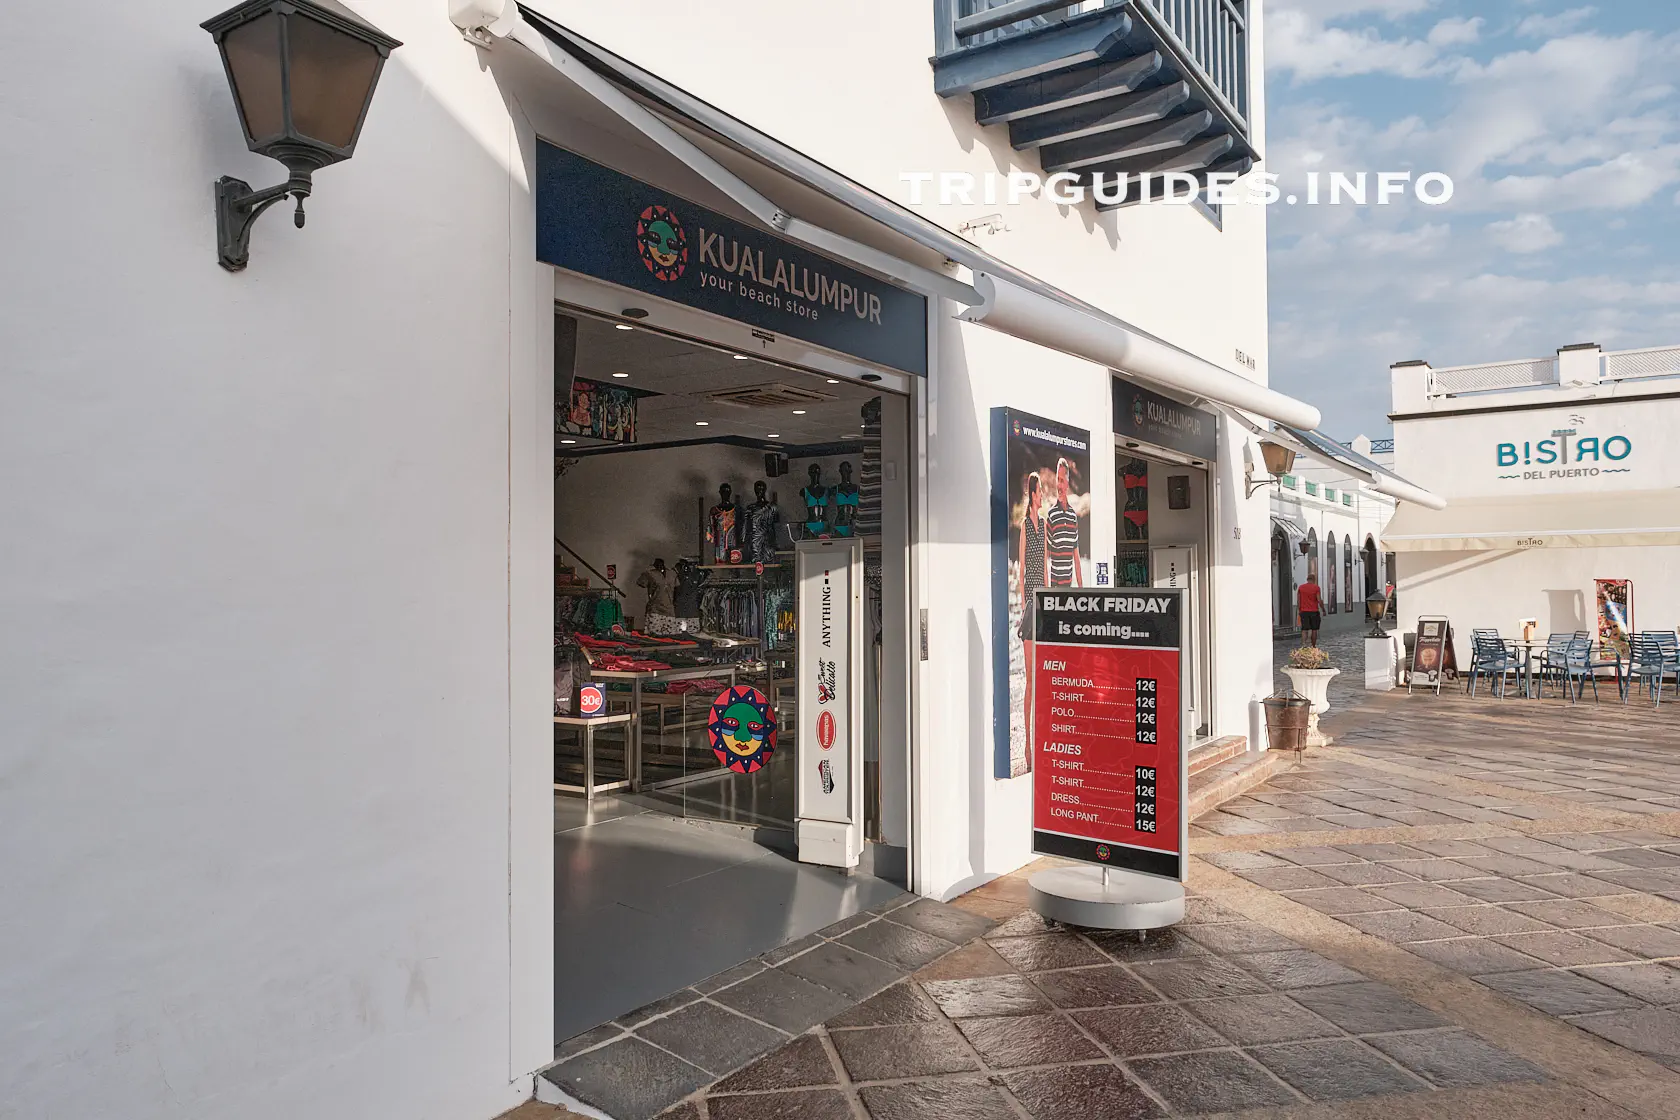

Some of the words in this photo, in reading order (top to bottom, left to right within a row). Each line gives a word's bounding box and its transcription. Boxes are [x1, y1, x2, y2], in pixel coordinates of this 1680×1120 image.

[699, 227, 882, 326] KUALALUMPUR
[700, 271, 733, 293] your
[739, 281, 781, 309] beach
[786, 300, 819, 321] store
[1147, 400, 1201, 436] KUALALUMPUR
[1523, 471, 1546, 480] DEL
[1549, 467, 1600, 479] PUERTO
[1043, 596, 1100, 612] BLACK
[1103, 597, 1172, 613] FRIDAY
[822, 586, 831, 648] ANYTHING
[1058, 621, 1071, 635] is
[1043, 660, 1067, 672] MEN
[1135, 680, 1156, 692] 12€
[581, 695, 601, 706] 30€
[1051, 692, 1085, 703] T-SHIRT
[1135, 696, 1156, 708] 12€
[1051, 707, 1075, 718] POLO
[1135, 713, 1156, 725] 12€
[1051, 723, 1077, 734] SHIRT
[1136, 731, 1156, 743] 12€
[1043, 741, 1082, 756] LADIES
[1051, 759, 1085, 771] T-SHIRT
[1135, 767, 1156, 780] 10€
[1051, 775, 1085, 788] T-SHIRT
[1135, 784, 1155, 798] 12€
[1051, 792, 1080, 805] DRESS
[1135, 802, 1155, 815] 12€
[1050, 807, 1075, 819] LONG
[1076, 811, 1099, 823] PANT
[1135, 819, 1156, 832] 15€
